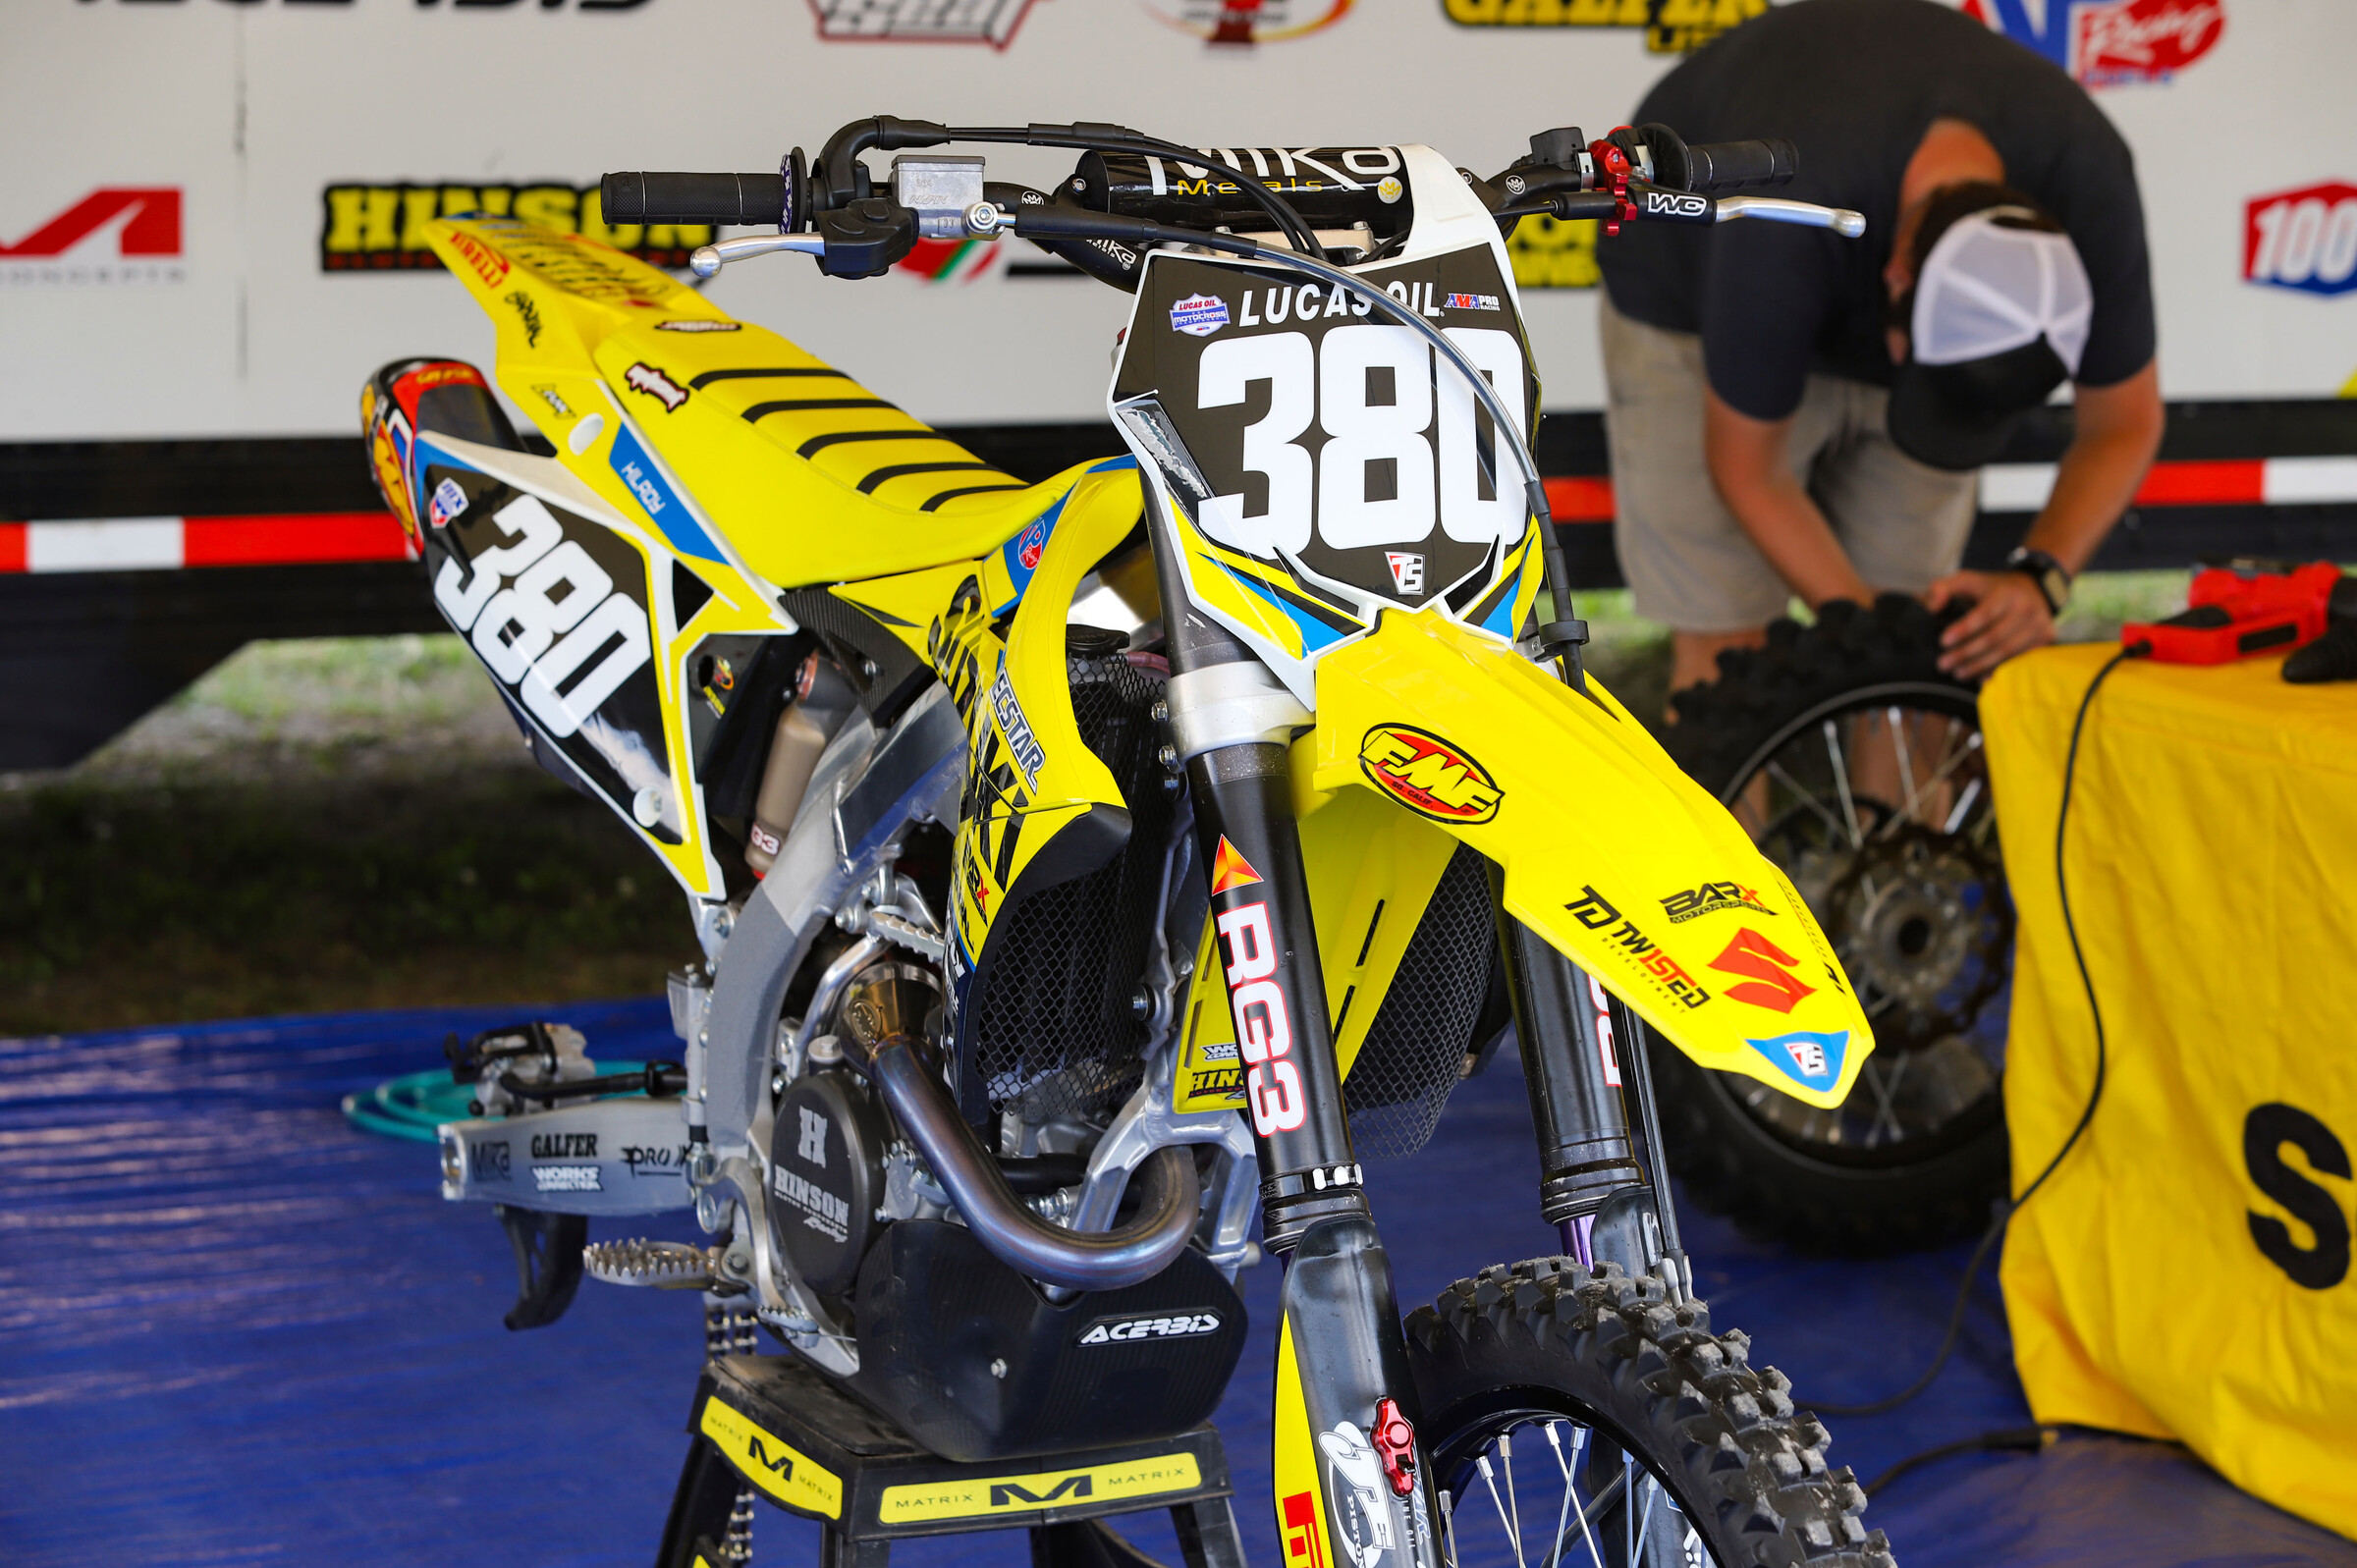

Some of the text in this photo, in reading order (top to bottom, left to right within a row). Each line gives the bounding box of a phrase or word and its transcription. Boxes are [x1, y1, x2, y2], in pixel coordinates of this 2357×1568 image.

[1178, 179, 1322, 195] Meals
[1174, 310, 1227, 323] MOTOCROSS
[1178, 300, 1203, 310] LUCAS
[1239, 283, 1372, 327] LUCAS
[1444, 293, 1500, 310] AMA PRO
[1197, 324, 1527, 561] 380
[434, 493, 652, 739] 380
[989, 668, 1046, 795] ECSTAR
[1359, 730, 1505, 813] FMF
[1216, 900, 1307, 1138] RG3
[1192, 1069, 1244, 1091] HIN
[531, 1133, 598, 1159] GALFER
[798, 1106, 828, 1168] H
[775, 1164, 849, 1226] HINSON
[1080, 1315, 1220, 1344] ACERBIS
[710, 1416, 743, 1441] MATRIX
[798, 1475, 833, 1502] MATRIX
[896, 1494, 973, 1508] MATRIX
[1109, 1468, 1184, 1487] MATRIX
